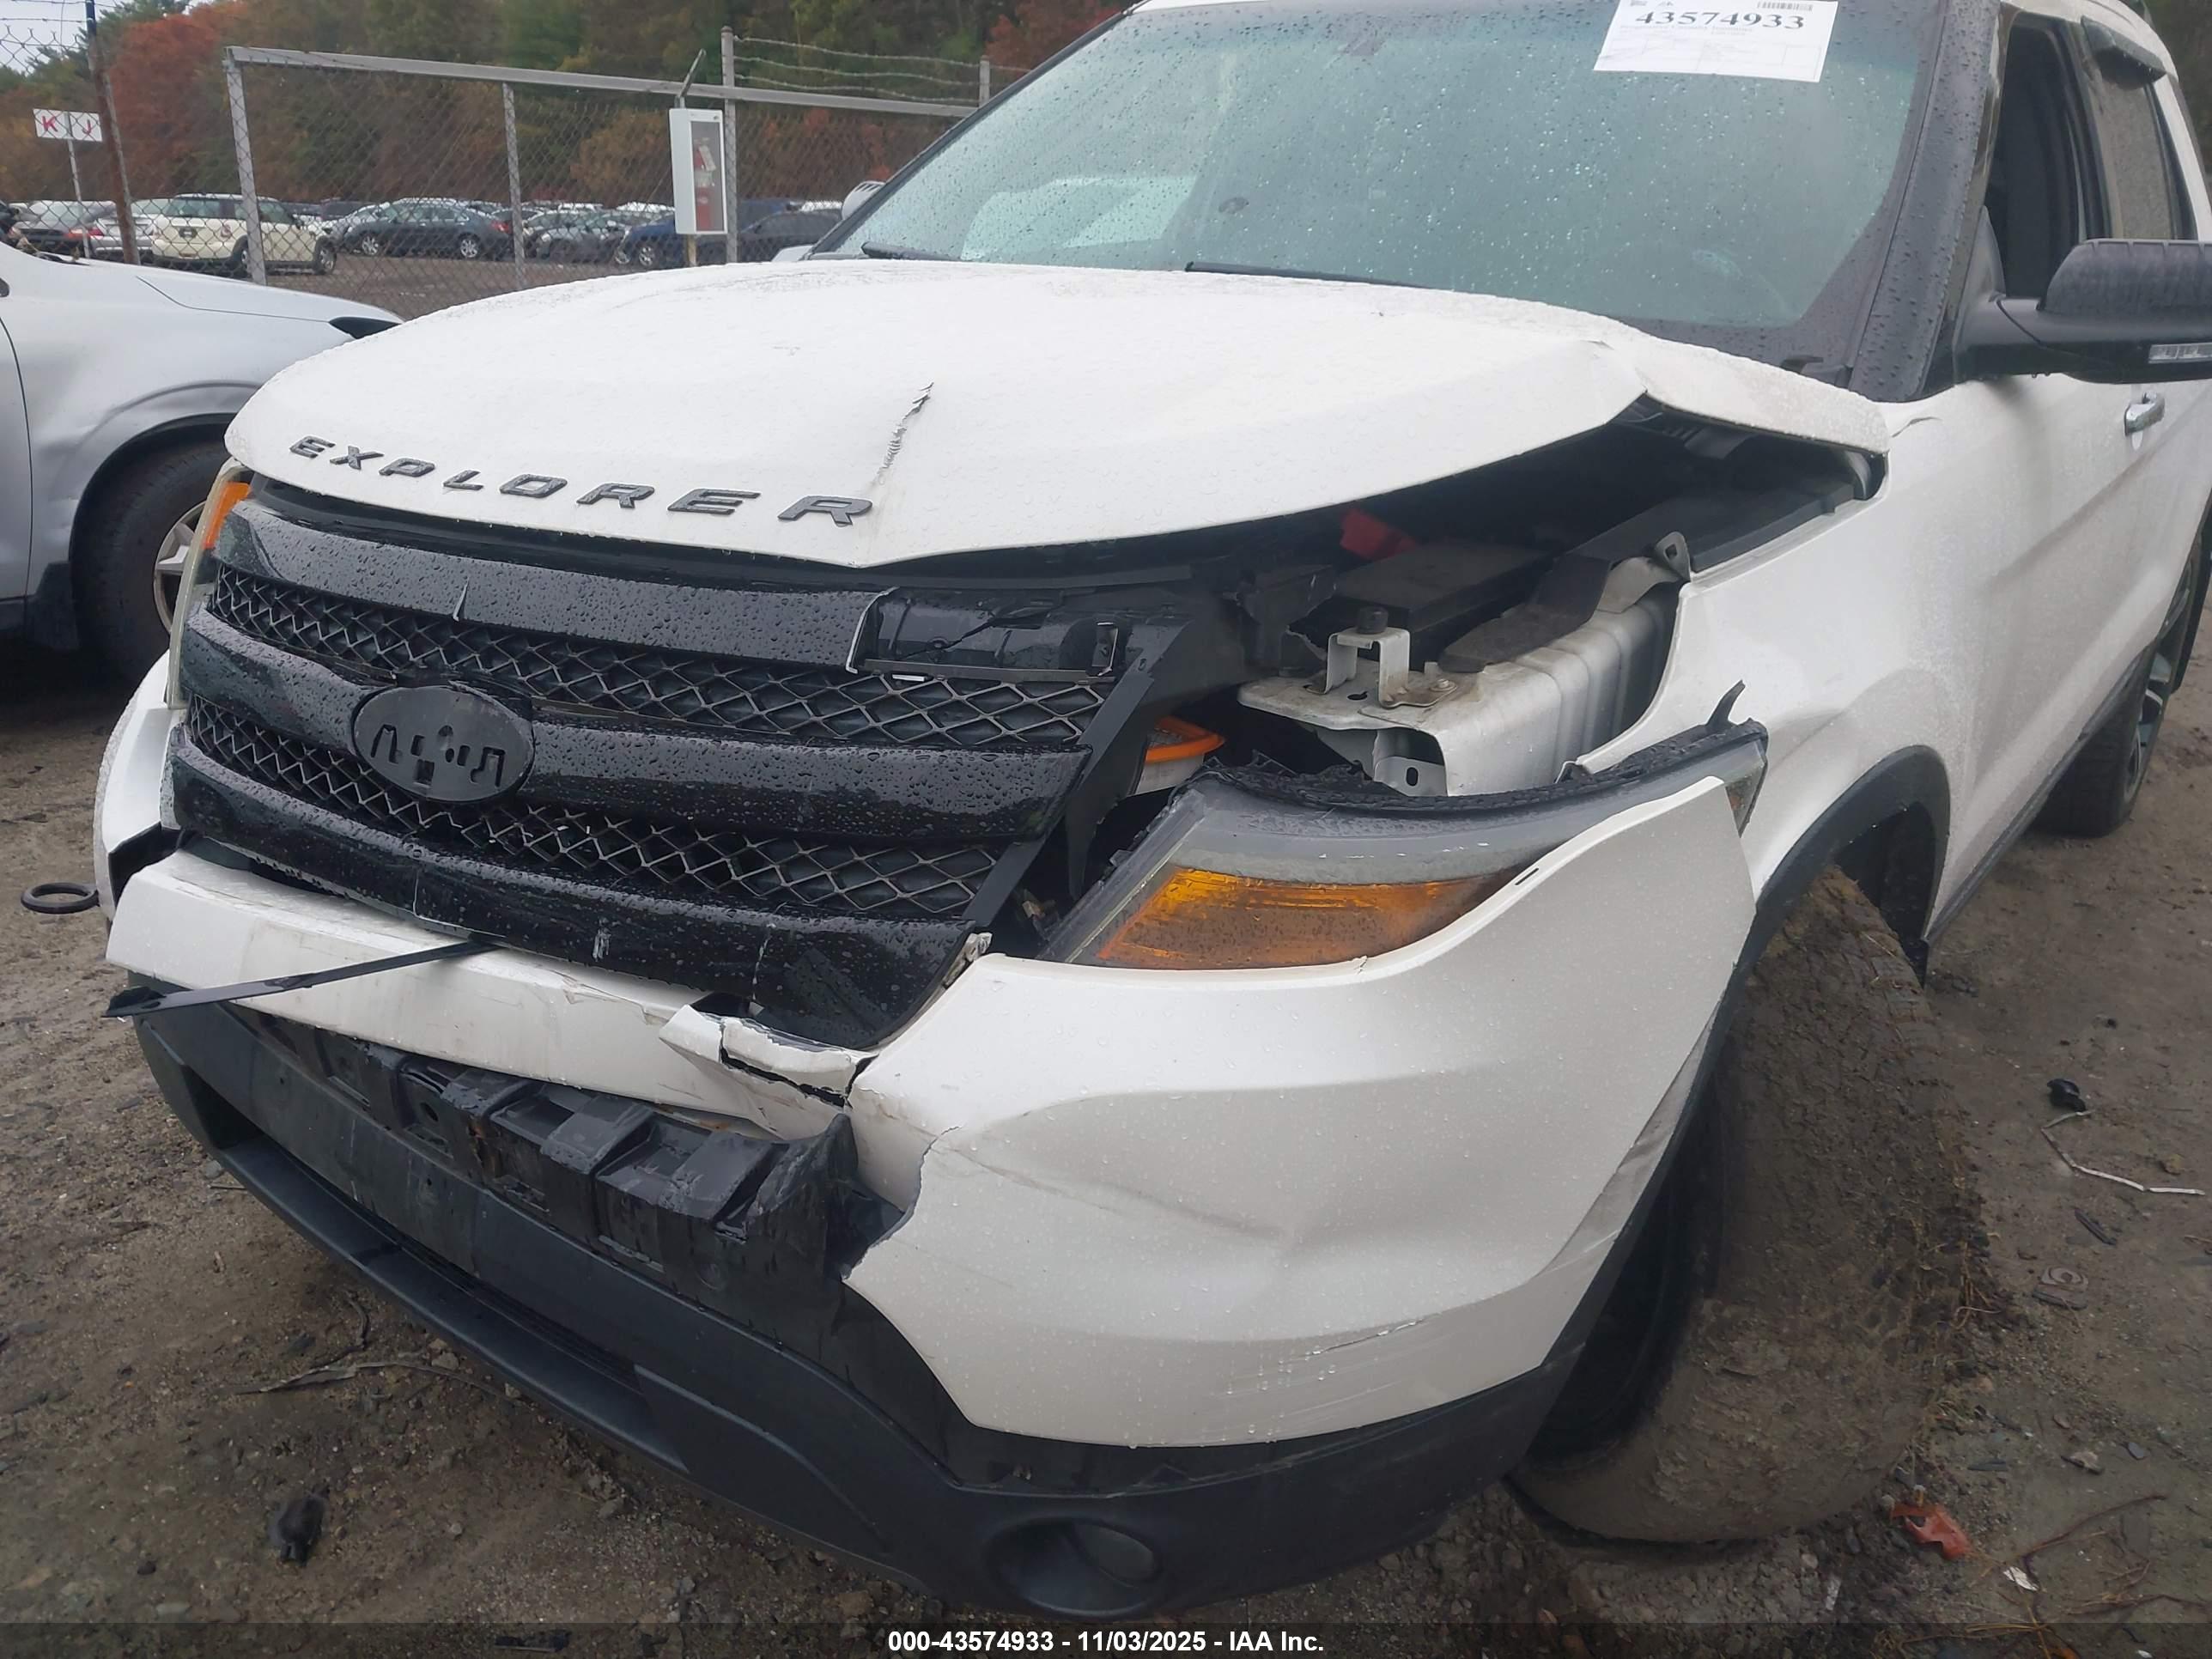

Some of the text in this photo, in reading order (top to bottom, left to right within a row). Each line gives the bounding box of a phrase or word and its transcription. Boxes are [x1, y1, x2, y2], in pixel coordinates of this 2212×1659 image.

[1636, 11, 1805, 29] 43574933
[42, 116, 93, 135] K J
[289, 434, 873, 526] EXPLORER
